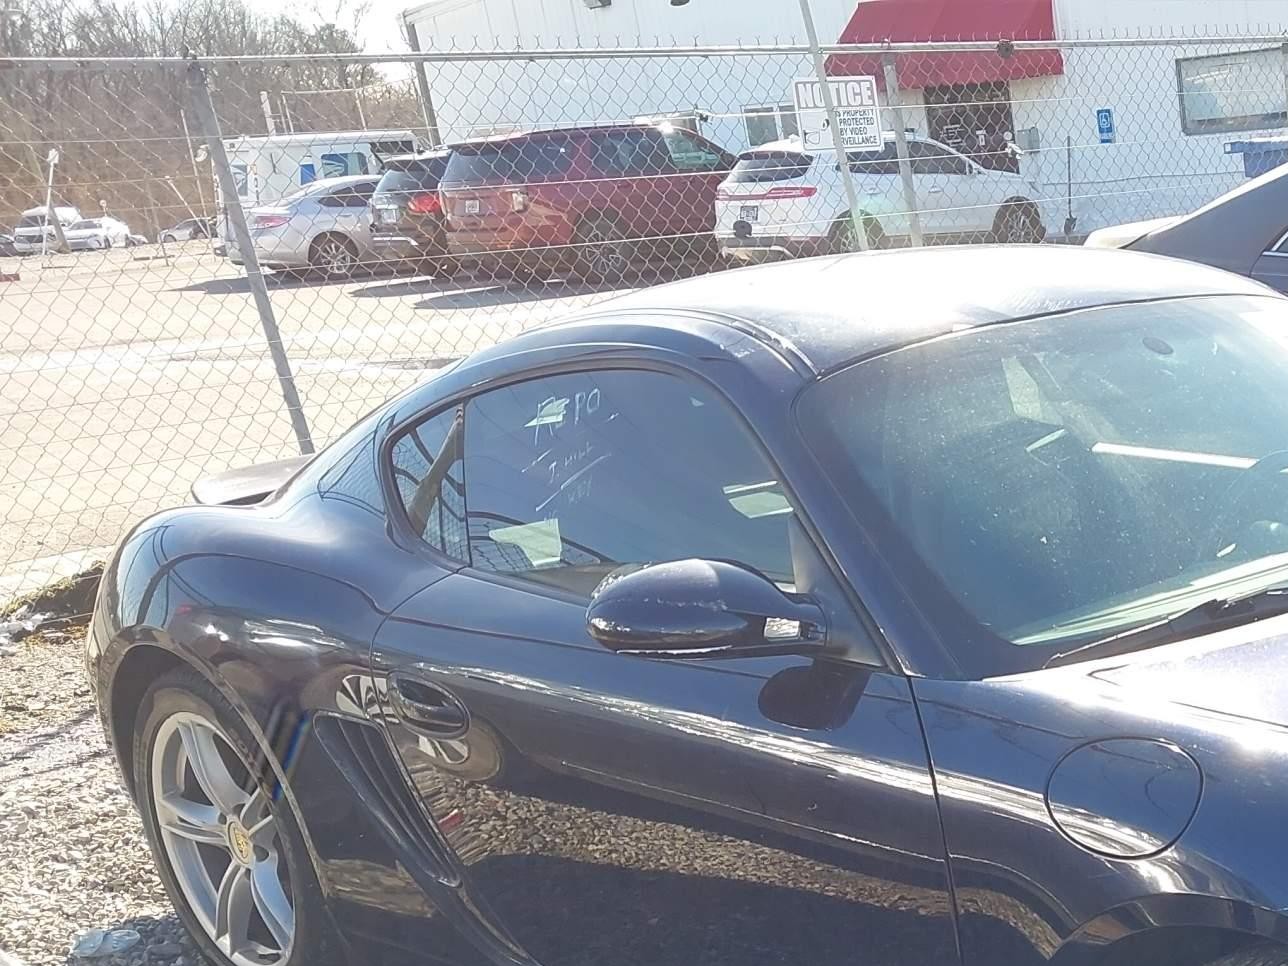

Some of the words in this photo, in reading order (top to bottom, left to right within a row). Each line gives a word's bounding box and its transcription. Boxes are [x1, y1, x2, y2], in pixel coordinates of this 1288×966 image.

[797, 81, 874, 108] NOTICE
[839, 116, 875, 127] PROTECTED
[840, 128, 848, 136] BY
[850, 126, 868, 136] VIDEO
[841, 135, 878, 146] RVEILLANCE
